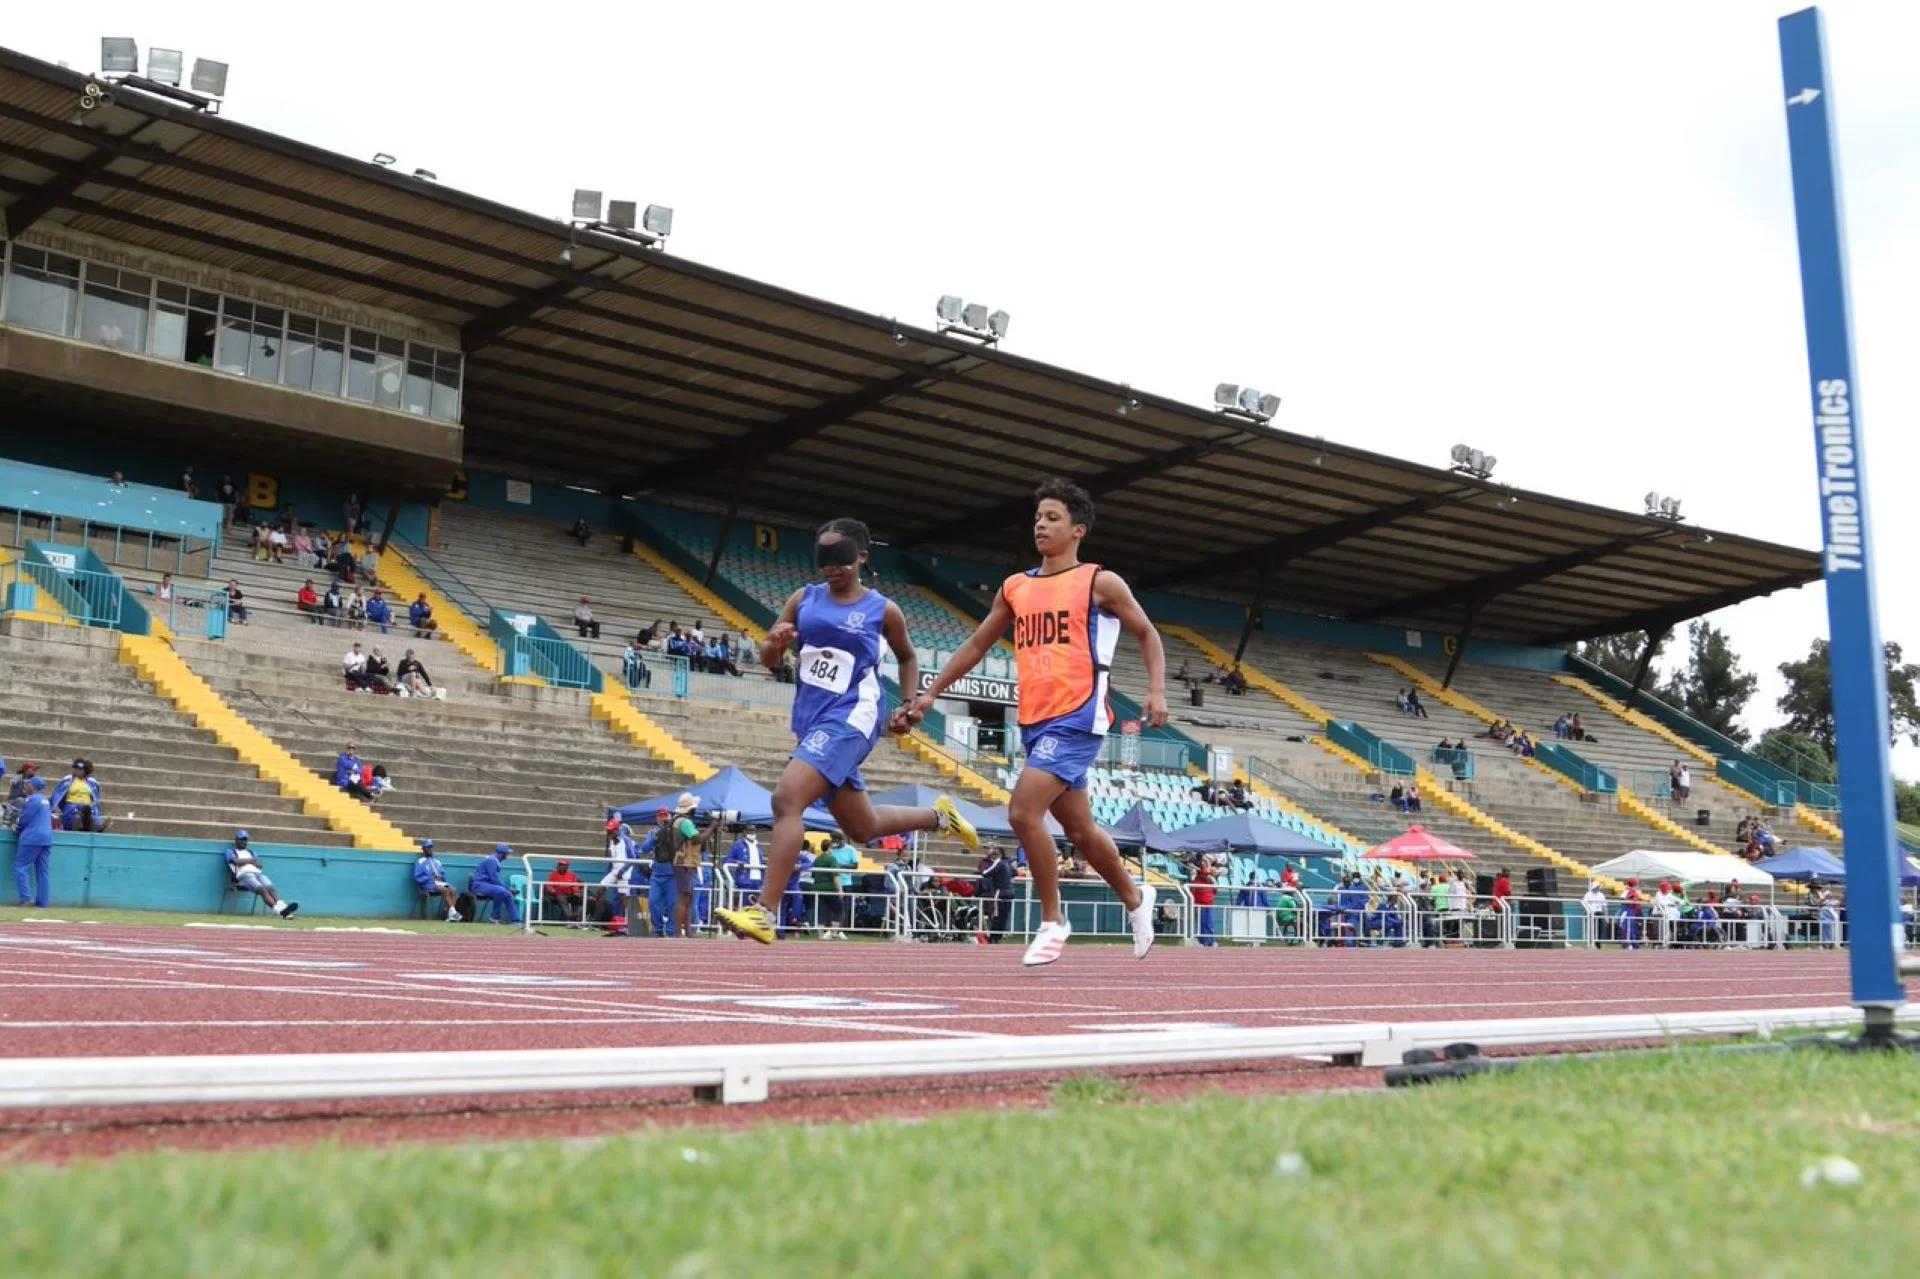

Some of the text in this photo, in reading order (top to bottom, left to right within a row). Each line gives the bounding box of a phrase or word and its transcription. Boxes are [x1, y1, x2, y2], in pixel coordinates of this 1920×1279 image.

[248, 473, 278, 508] B
[1816, 378, 1863, 573] TimeTronics
[1016, 610, 1071, 650] GUIDE
[809, 659, 839, 682] 484
[921, 673, 1010, 700] GMISTON
